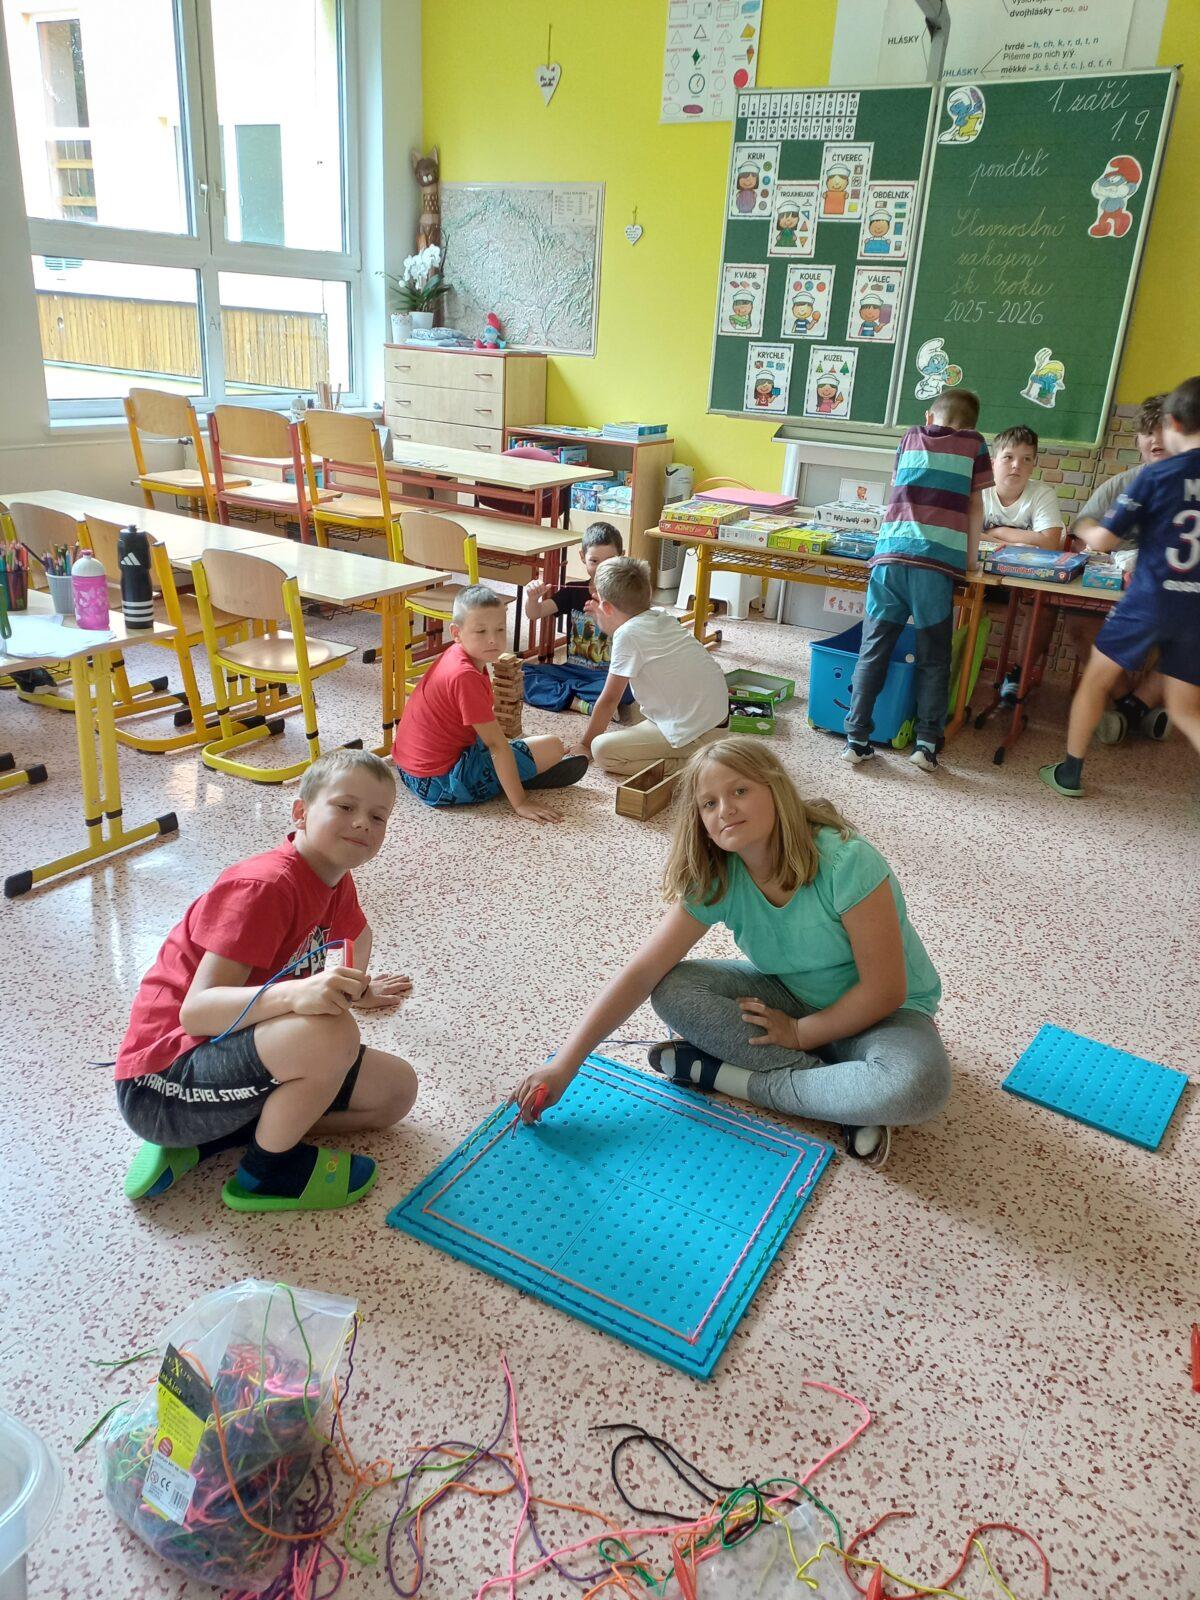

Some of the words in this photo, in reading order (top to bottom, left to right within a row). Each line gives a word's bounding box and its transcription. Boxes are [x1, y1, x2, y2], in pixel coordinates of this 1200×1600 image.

[1009, 6, 1053, 17] dvojhlásky
[887, 35, 919, 45] HLÁSKY
[1004, 42, 1025, 51] tvrdé
[1033, 52, 1042, 60] po
[1044, 50, 1060, 58] nich
[1000, 65, 1026, 74] měkké
[1048, 81, 1064, 113] 1.
[1066, 79, 1130, 112] září
[741, 102, 746, 110] 0
[772, 102, 778, 110] 3
[783, 102, 789, 110] 4
[828, 101, 833, 109] 8
[849, 100, 858, 109] 10
[779, 125, 787, 133] 14
[790, 125, 797, 133] 15
[801, 125, 809, 133] 16
[812, 125, 820, 133] 17
[824, 124, 832, 133] 18
[835, 124, 842, 133] 19
[845, 125, 854, 133] 20
[747, 152, 766, 161] KRUH
[831, 153, 863, 162] ČTVEREC
[968, 147, 1049, 196] pondělí
[872, 190, 910, 199] OBDÉLNÍK
[951, 206, 1066, 238] Slavnostní
[953, 239, 1048, 283] zahájení
[734, 270, 757, 279] KVÁDR
[800, 272, 822, 281] KOULE
[867, 274, 891, 283] VÁLEC
[992, 267, 1055, 296] roku
[757, 351, 785, 360] KRYCHLE
[823, 353, 844, 362] KUŽEL
[185, 1088, 220, 1103] LEVEL
[219, 1086, 259, 1102] START
